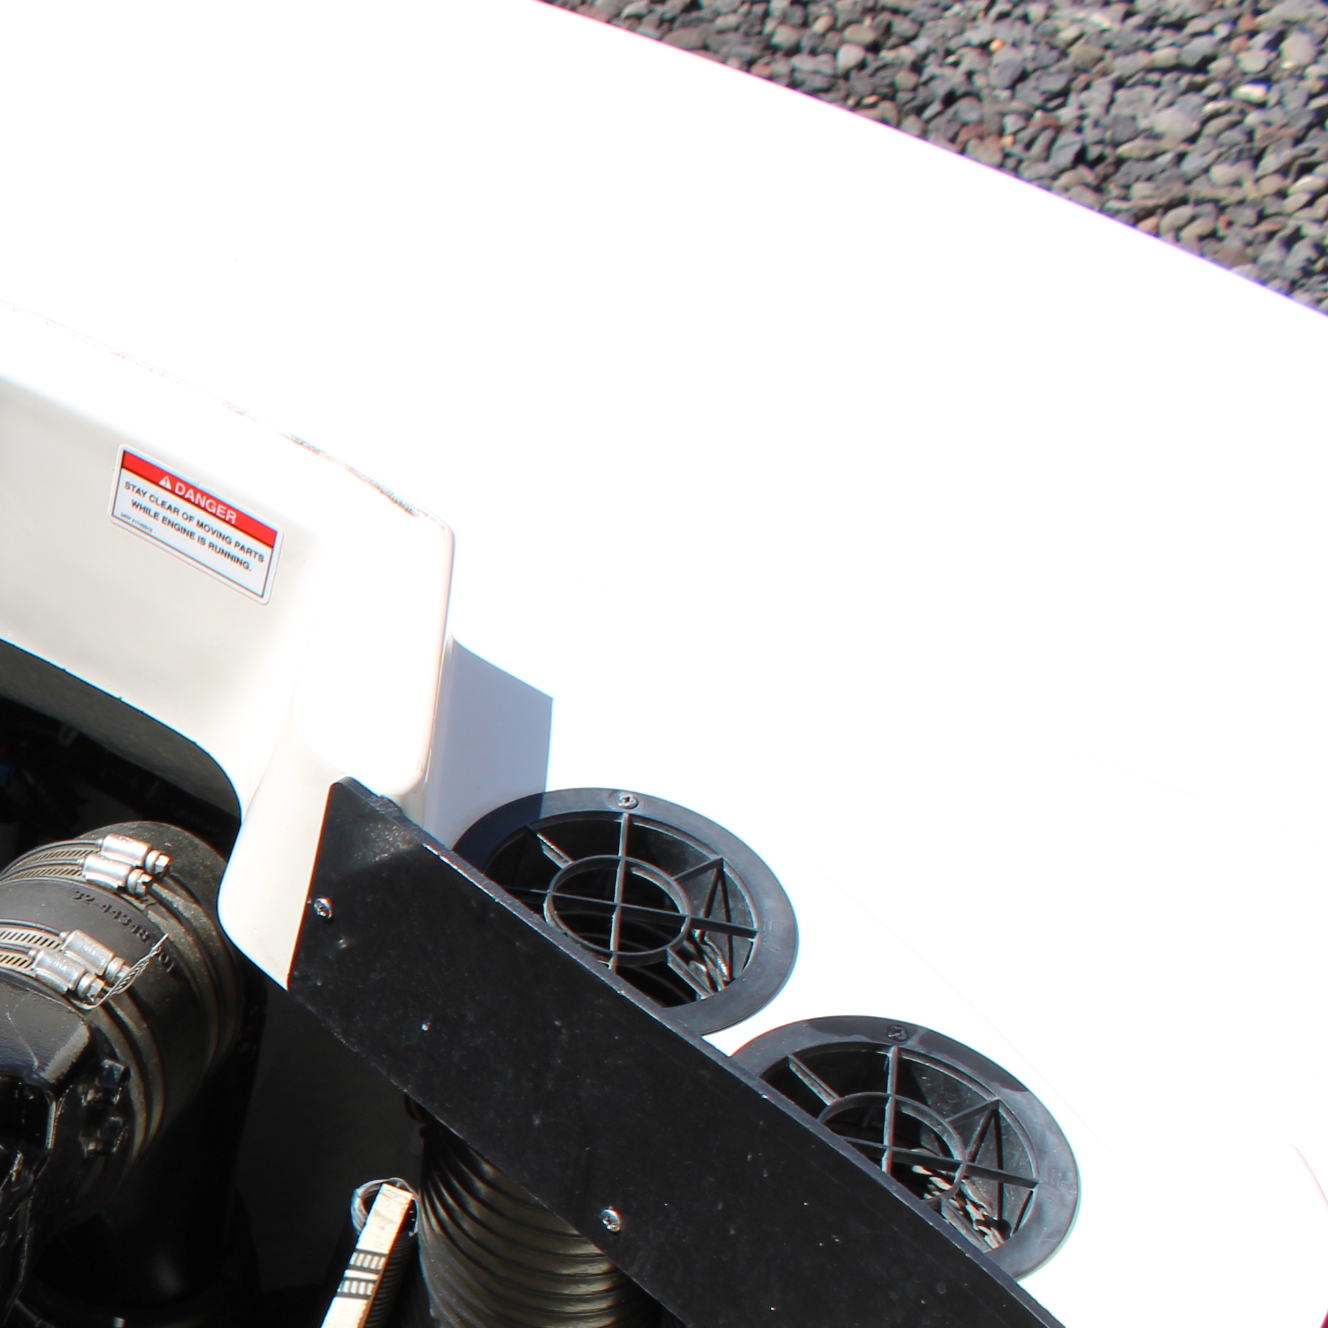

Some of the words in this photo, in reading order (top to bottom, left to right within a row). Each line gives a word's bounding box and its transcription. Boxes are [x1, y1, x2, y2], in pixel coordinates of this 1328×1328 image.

[124, 481, 148, 498] STAY
[149, 493, 180, 516] CLEAR
[181, 511, 194, 523] OF
[195, 519, 233, 545] MOVING
[233, 539, 265, 563] PARTS
[131, 500, 160, 521] WHILE
[161, 515, 195, 540] ENGINE
[197, 535, 207, 546] IS
[207, 540, 252, 572] RUNNING.
[174, 481, 237, 525] DANGER
